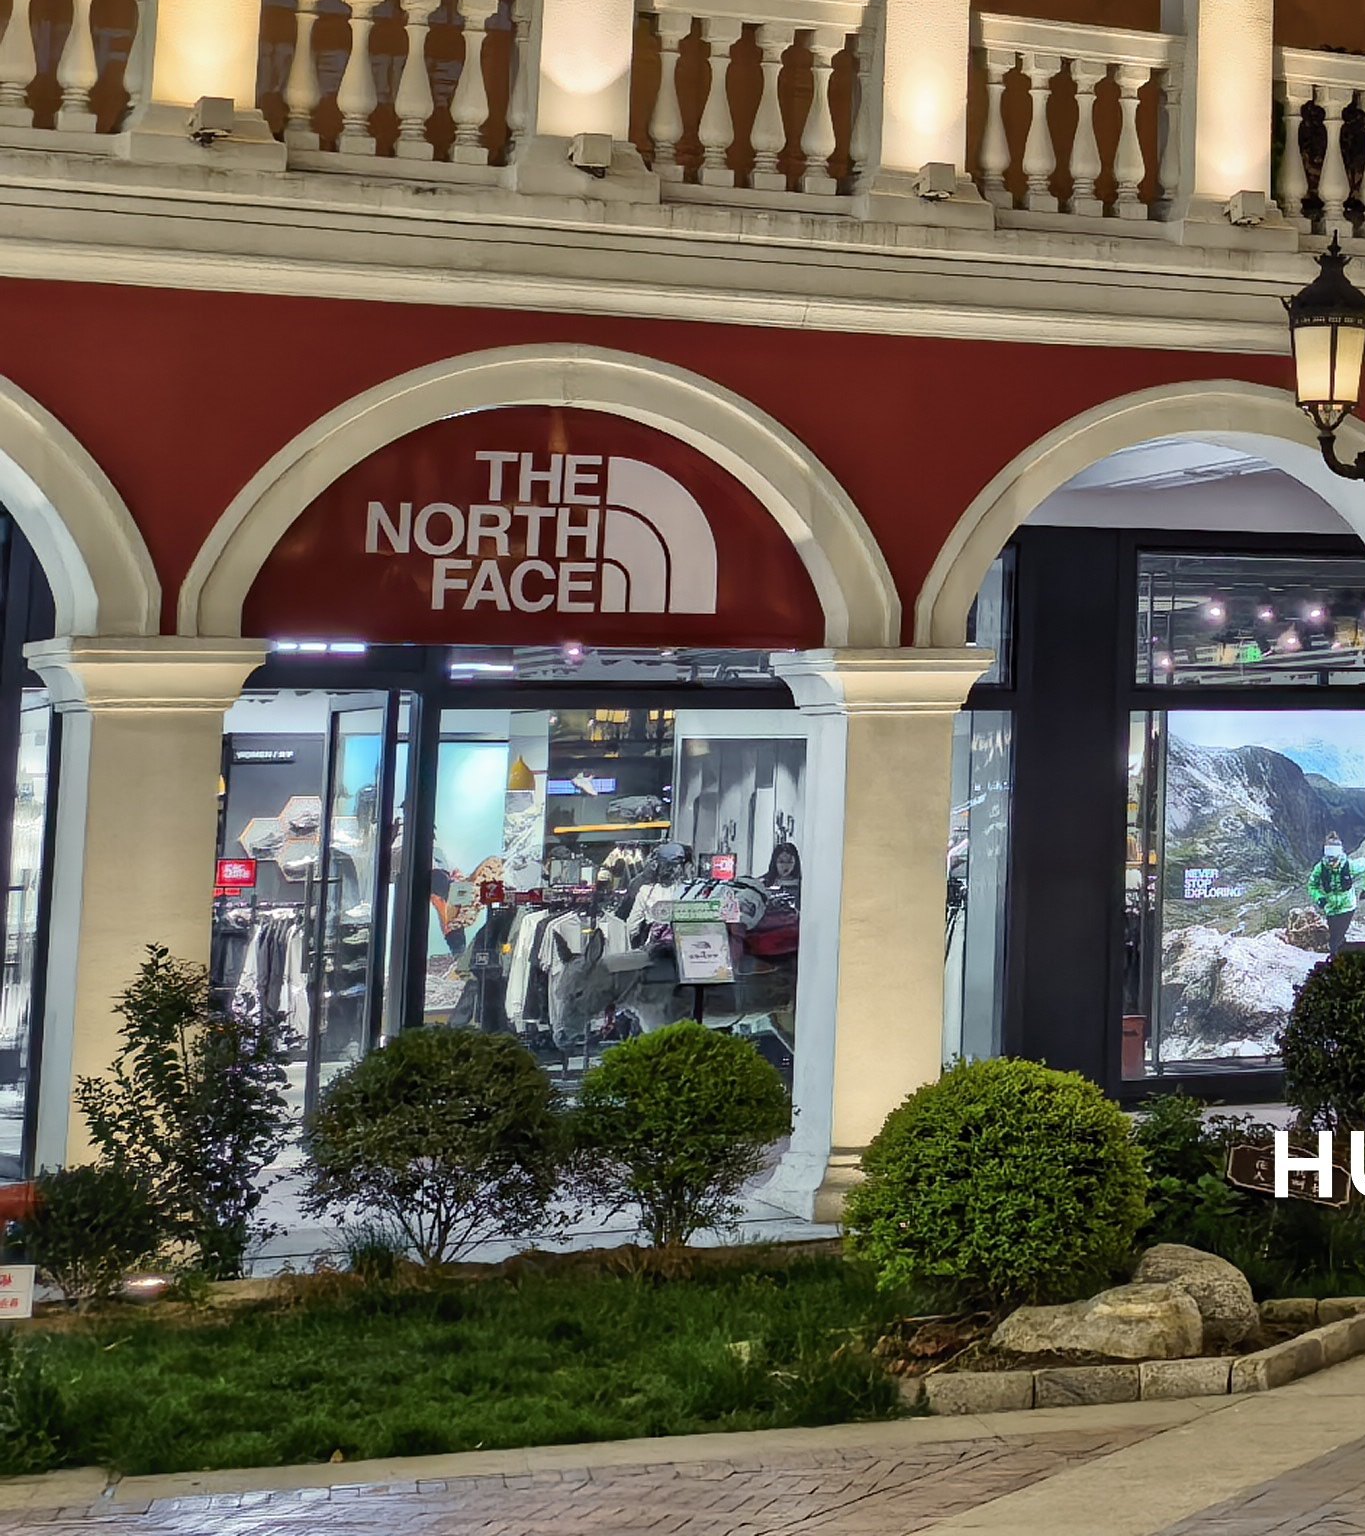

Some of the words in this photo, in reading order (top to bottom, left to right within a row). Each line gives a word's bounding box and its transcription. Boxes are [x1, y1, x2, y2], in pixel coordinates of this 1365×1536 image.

[475, 450, 603, 505] THE
[364, 501, 600, 559] NORTH
[431, 558, 598, 614] FACE
[1184, 868, 1219, 879] NEVER
[1184, 878, 1212, 889] STOP
[1184, 887, 1246, 899] EXPLORING
